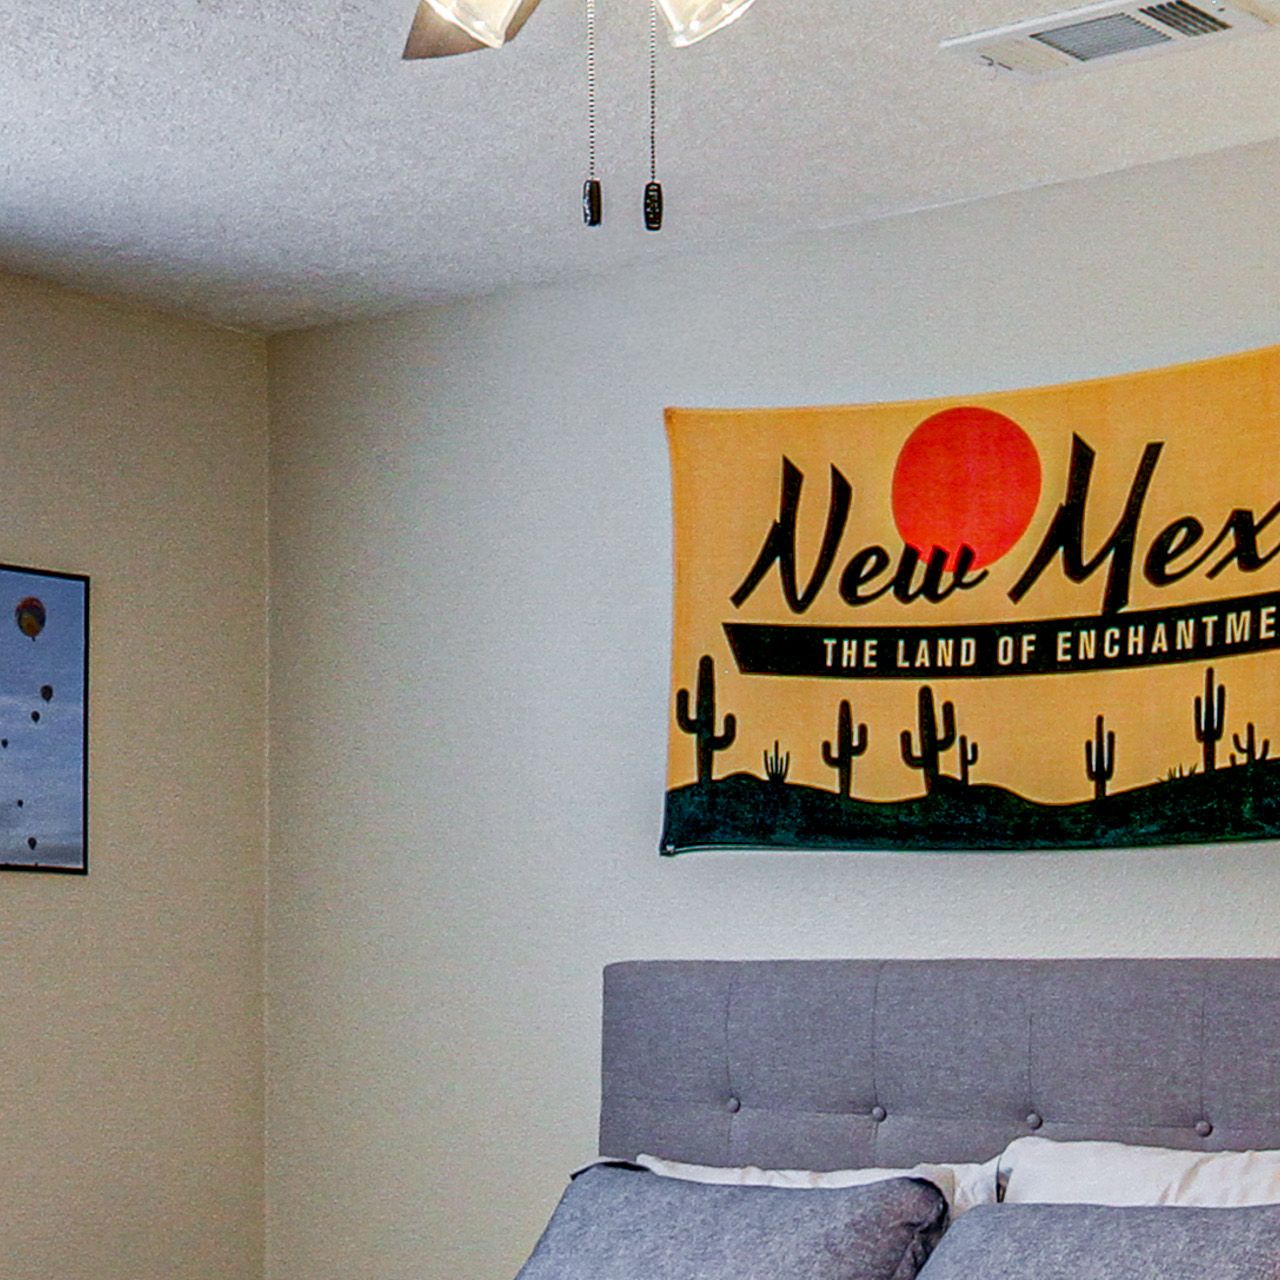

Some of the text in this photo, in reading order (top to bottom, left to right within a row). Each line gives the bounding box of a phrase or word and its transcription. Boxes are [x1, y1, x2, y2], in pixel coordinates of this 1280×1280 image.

[730, 454, 988, 614] New
[823, 638, 878, 669] THE
[896, 636, 977, 669] LAND
[997, 633, 1037, 665] OF
